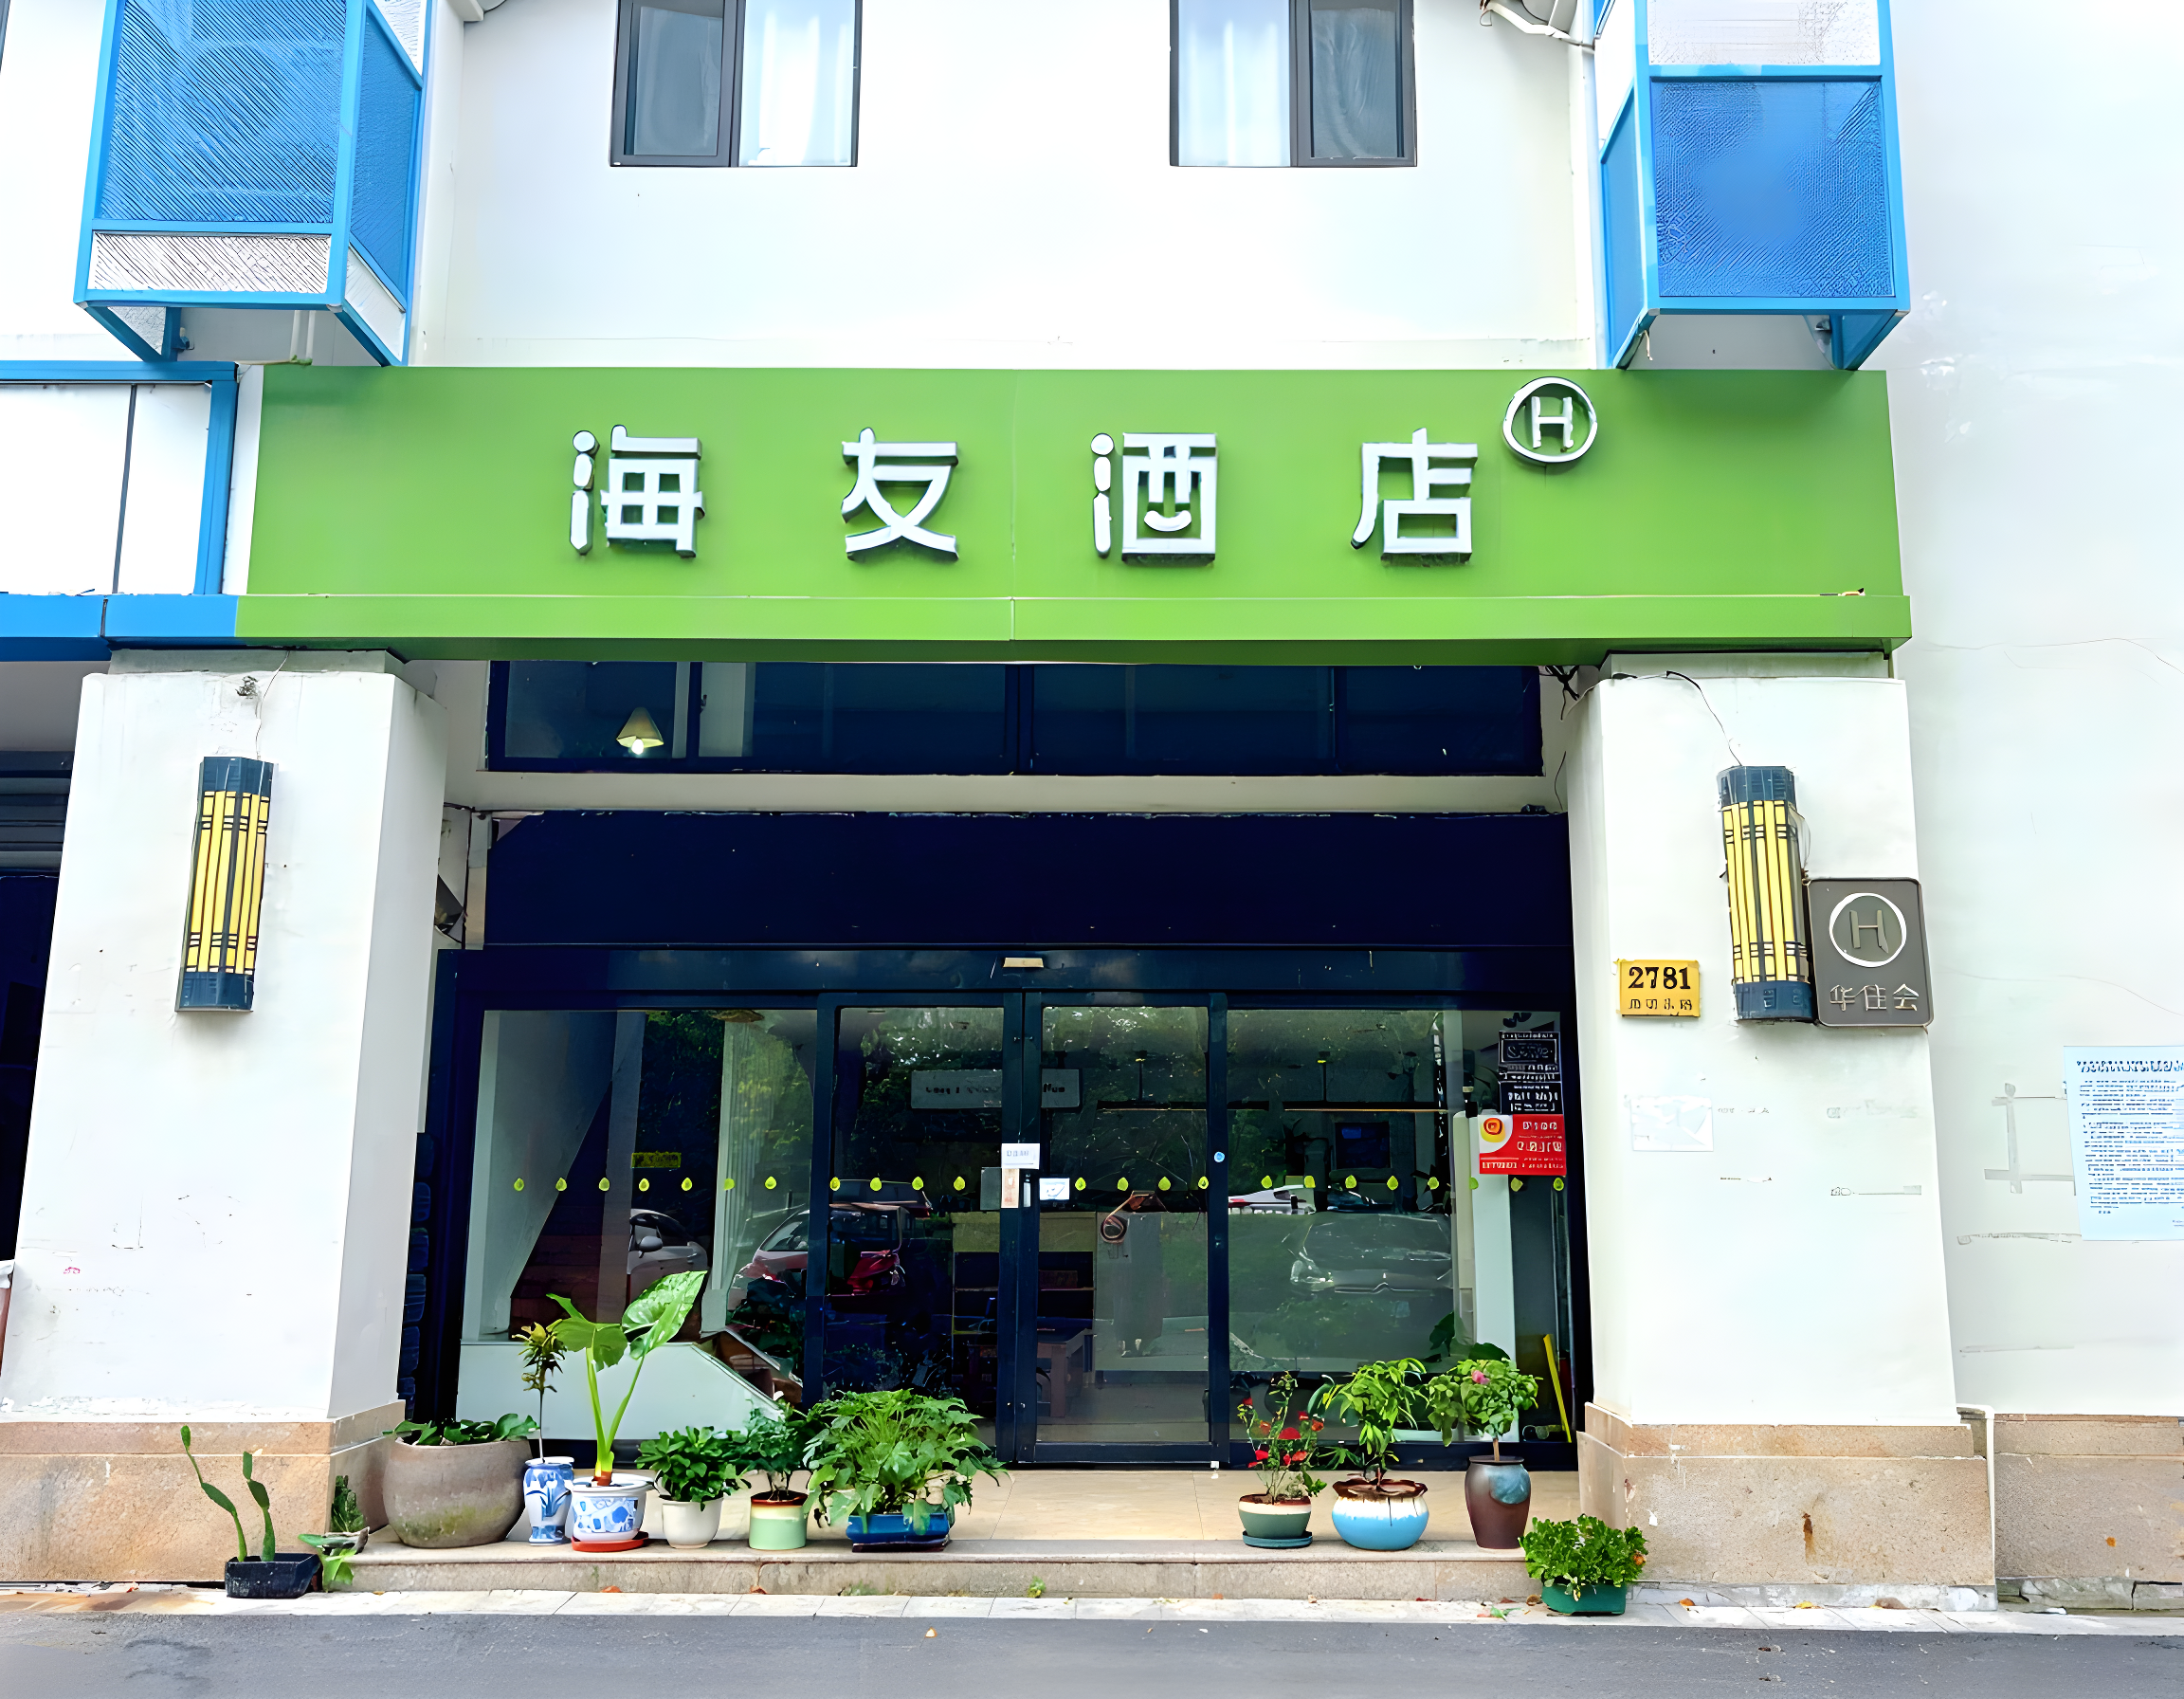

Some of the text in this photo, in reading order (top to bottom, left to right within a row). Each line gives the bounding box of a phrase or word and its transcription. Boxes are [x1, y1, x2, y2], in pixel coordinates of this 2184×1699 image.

[570, 424, 1479, 562] 海友酒店
[1628, 966, 1691, 990] 2781
[1829, 983, 1920, 1012] 华住会
